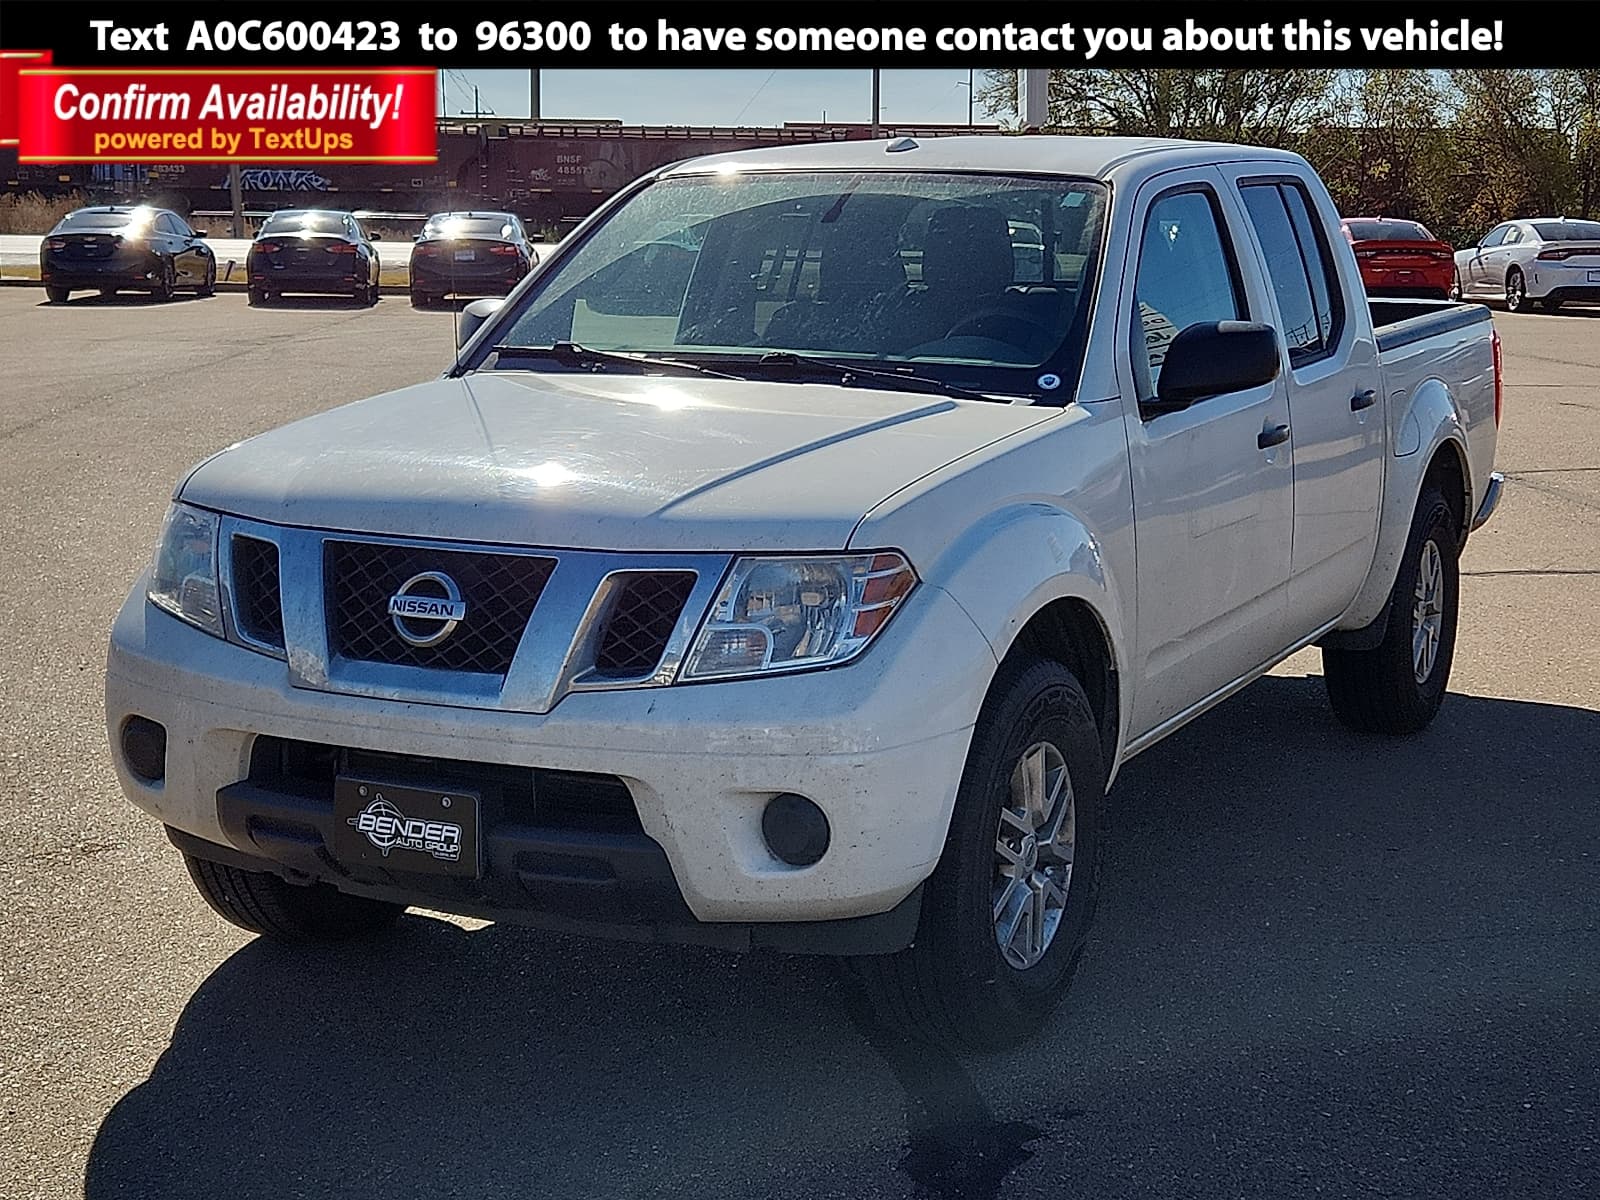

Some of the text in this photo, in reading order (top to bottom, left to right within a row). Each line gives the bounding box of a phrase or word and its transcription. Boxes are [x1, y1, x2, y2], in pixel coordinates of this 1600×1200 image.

[556, 155, 582, 164] BNSF
[392, 599, 455, 616] NISSAN
[358, 813, 460, 844] BENDER
[395, 836, 459, 853] AUTO GROUP
